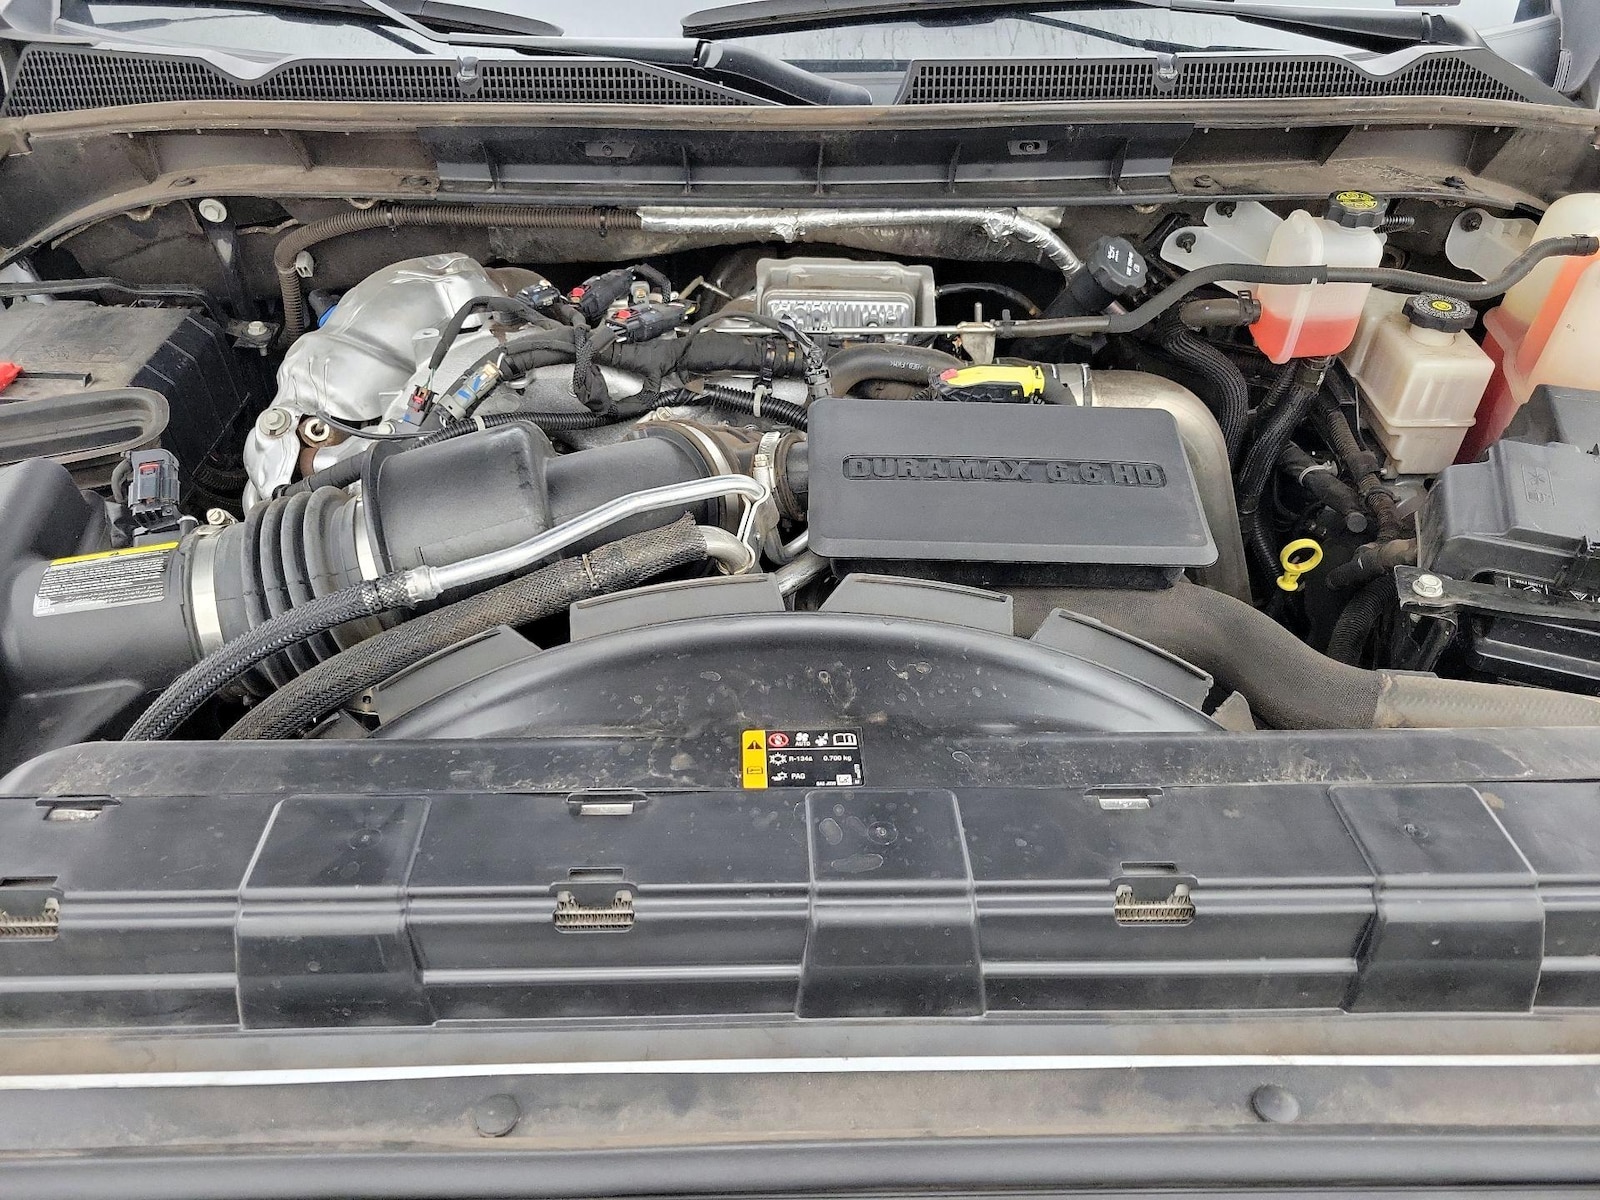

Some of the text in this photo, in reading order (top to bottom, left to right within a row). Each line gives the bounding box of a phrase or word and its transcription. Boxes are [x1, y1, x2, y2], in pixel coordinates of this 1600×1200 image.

[848, 458, 1162, 486] DURAMAX 6.6 HD
[791, 772, 806, 780] PAG
